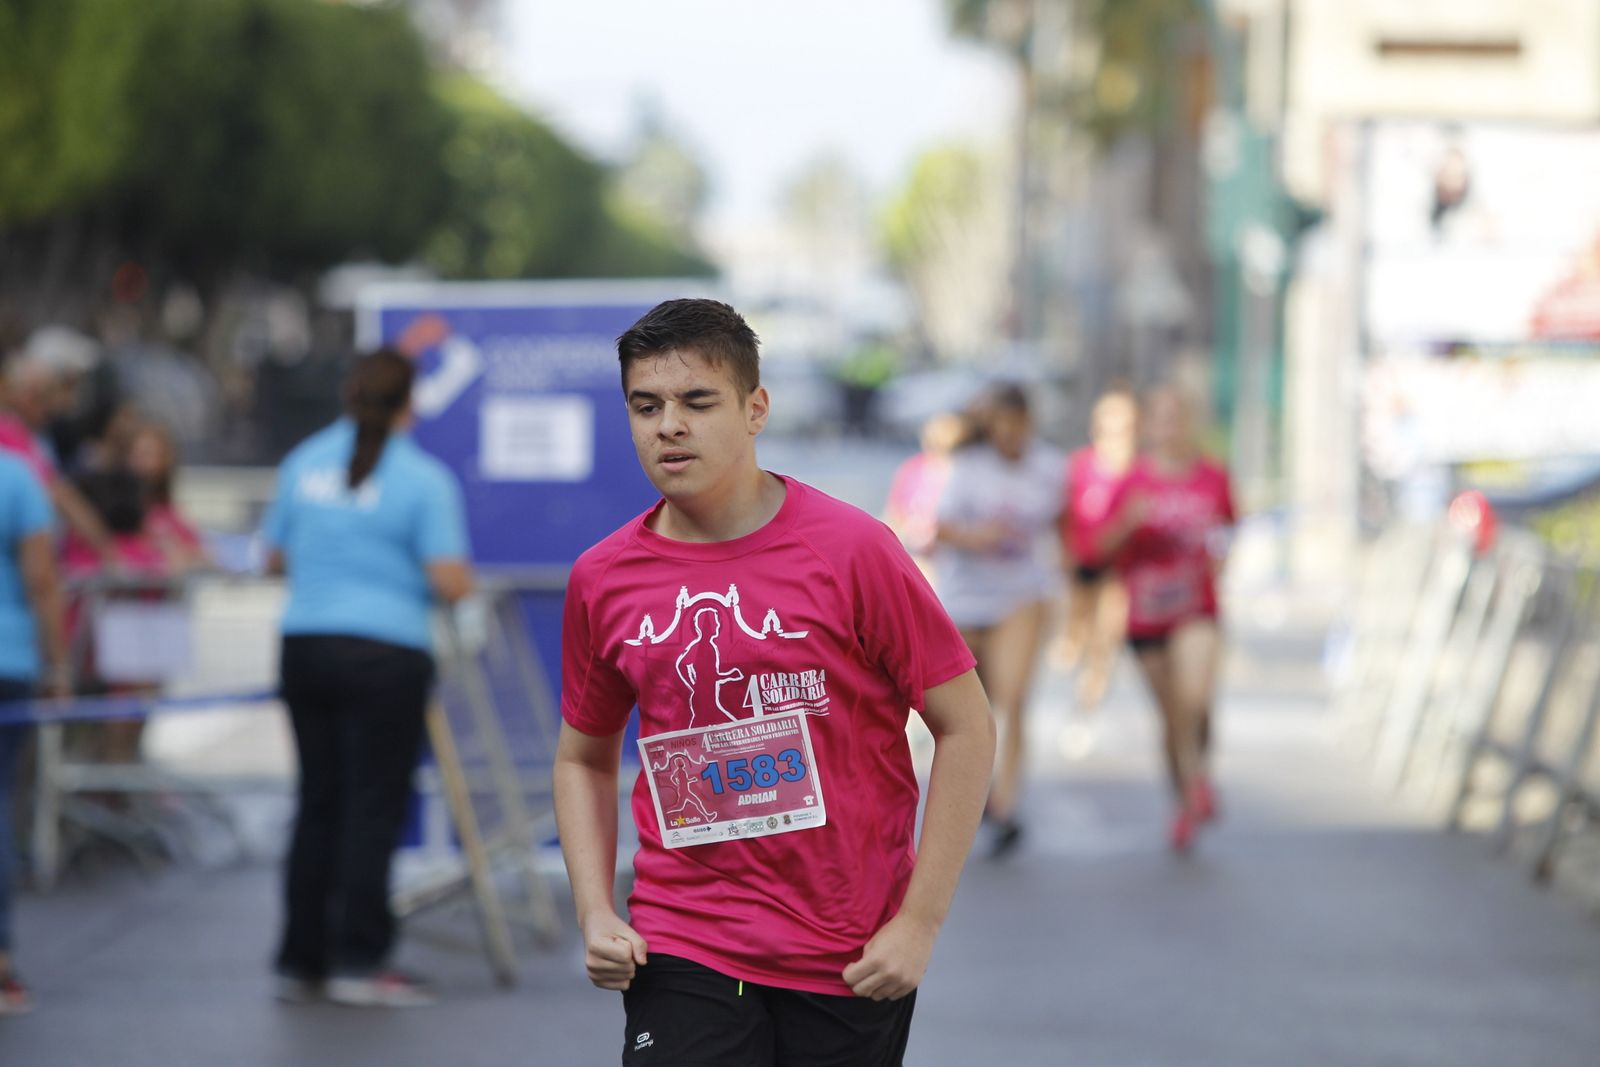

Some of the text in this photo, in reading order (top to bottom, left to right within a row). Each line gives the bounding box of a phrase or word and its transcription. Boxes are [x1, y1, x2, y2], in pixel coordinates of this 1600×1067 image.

[742, 669, 826, 718] 4 CARRERA
[762, 682, 827, 705] SOLIDARIA
[671, 737, 697, 749] NIÑOS
[701, 732, 713, 753] 4
[709, 728, 751, 744] CARRERA
[751, 718, 798, 736] SOLIDARIA
[760, 733, 772, 741] POCO
[701, 748, 807, 795] 1583
[738, 790, 777, 806] ADRIAN
[685, 816, 701, 824] Salle
